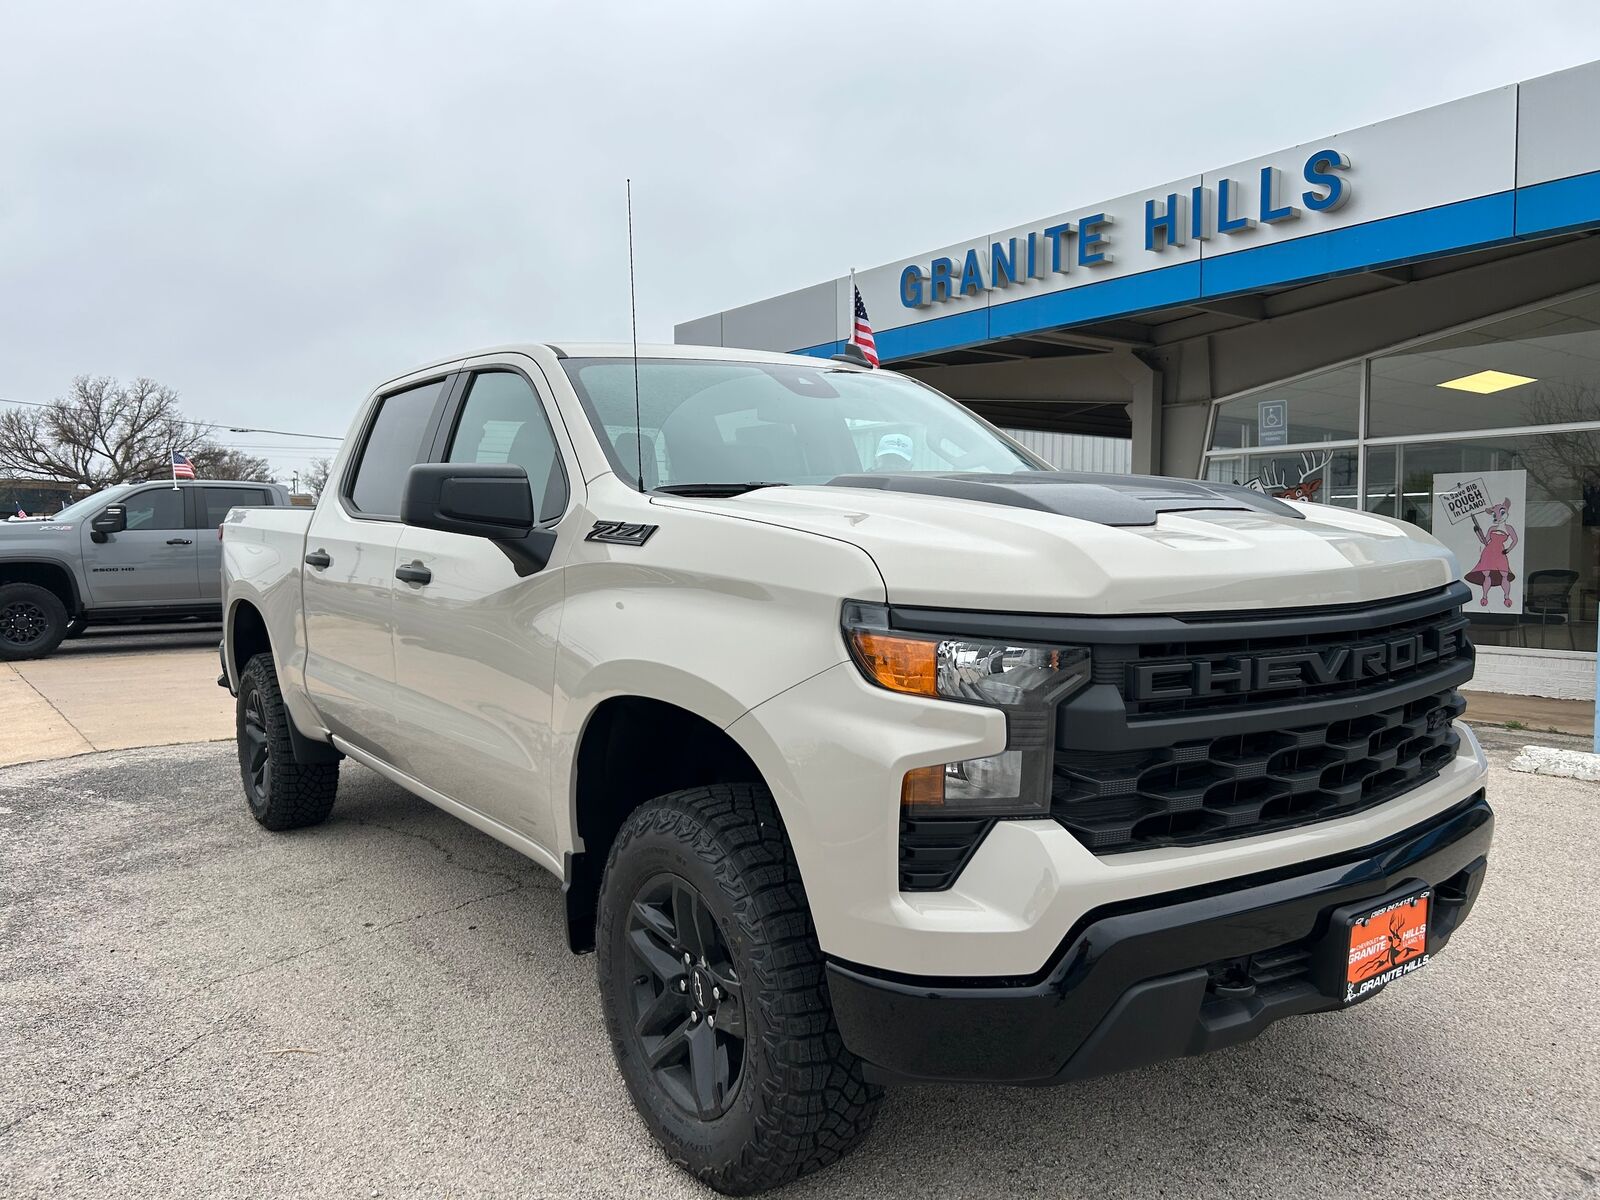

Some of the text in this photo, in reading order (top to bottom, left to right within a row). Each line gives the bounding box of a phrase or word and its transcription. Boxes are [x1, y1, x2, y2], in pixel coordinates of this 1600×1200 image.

[900, 149, 1350, 309] GRANITE HILLS
[1448, 489, 1483, 511] DOUGH
[584, 520, 659, 547] Z71
[1402, 923, 1426, 942] HILLS
[1348, 940, 1386, 965] GRANITE
[1360, 954, 1430, 994] GRANITE HILLS
